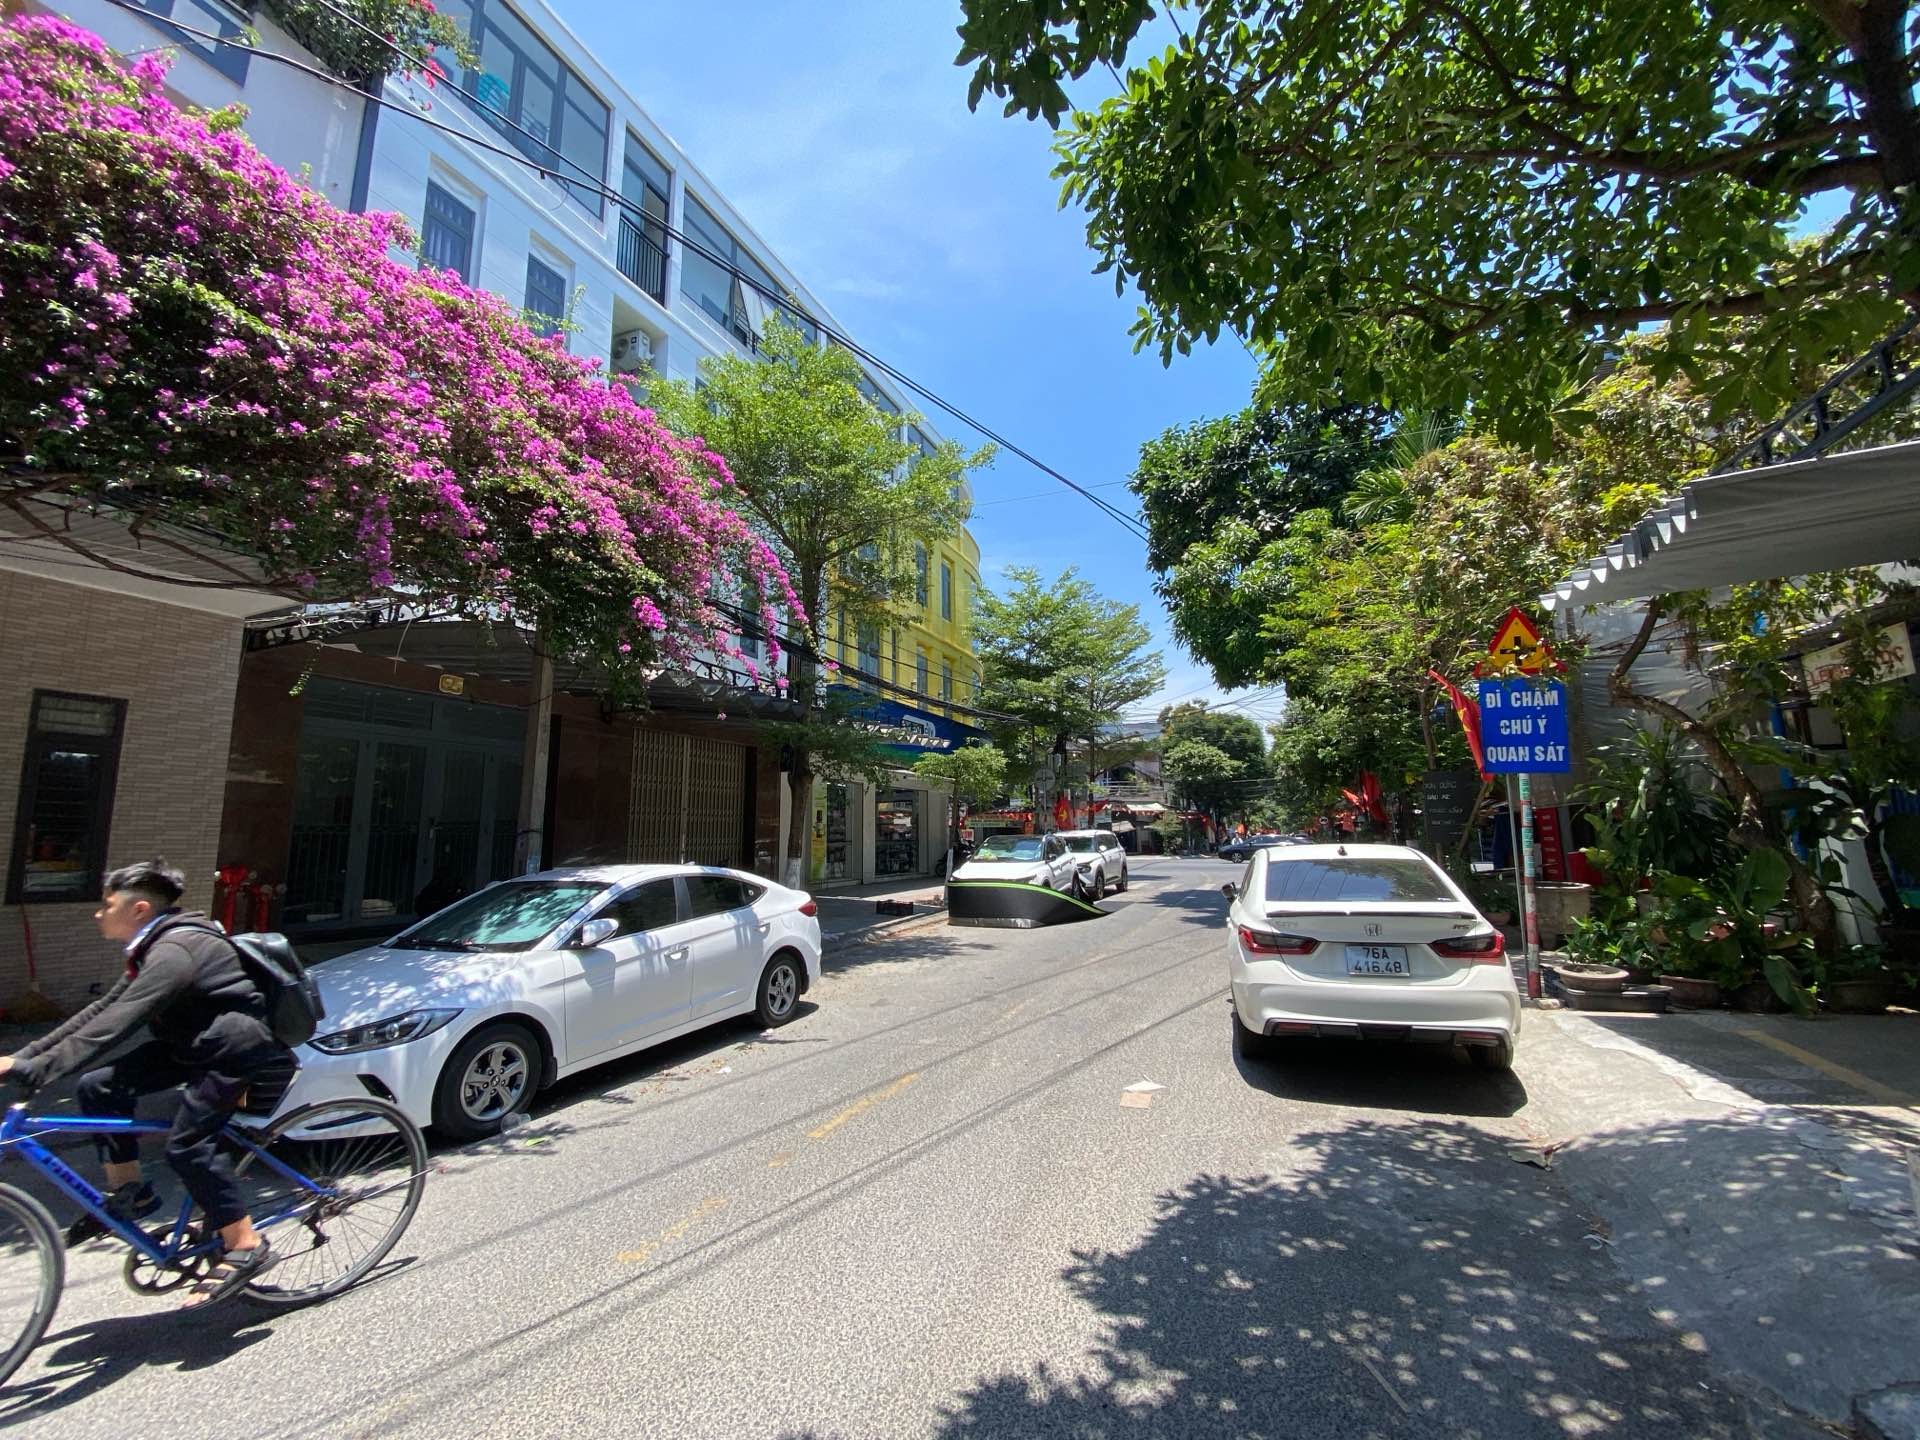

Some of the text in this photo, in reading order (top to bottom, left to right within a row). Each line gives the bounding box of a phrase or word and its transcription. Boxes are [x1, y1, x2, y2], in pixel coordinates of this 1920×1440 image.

[1511, 687, 1559, 710] CHẬM
[1500, 714, 1548, 735] CHÚ Ý
[1486, 741, 1565, 763] QUAN SÁT
[1362, 947, 1390, 960] 76A
[1354, 961, 1403, 973] 416.48
